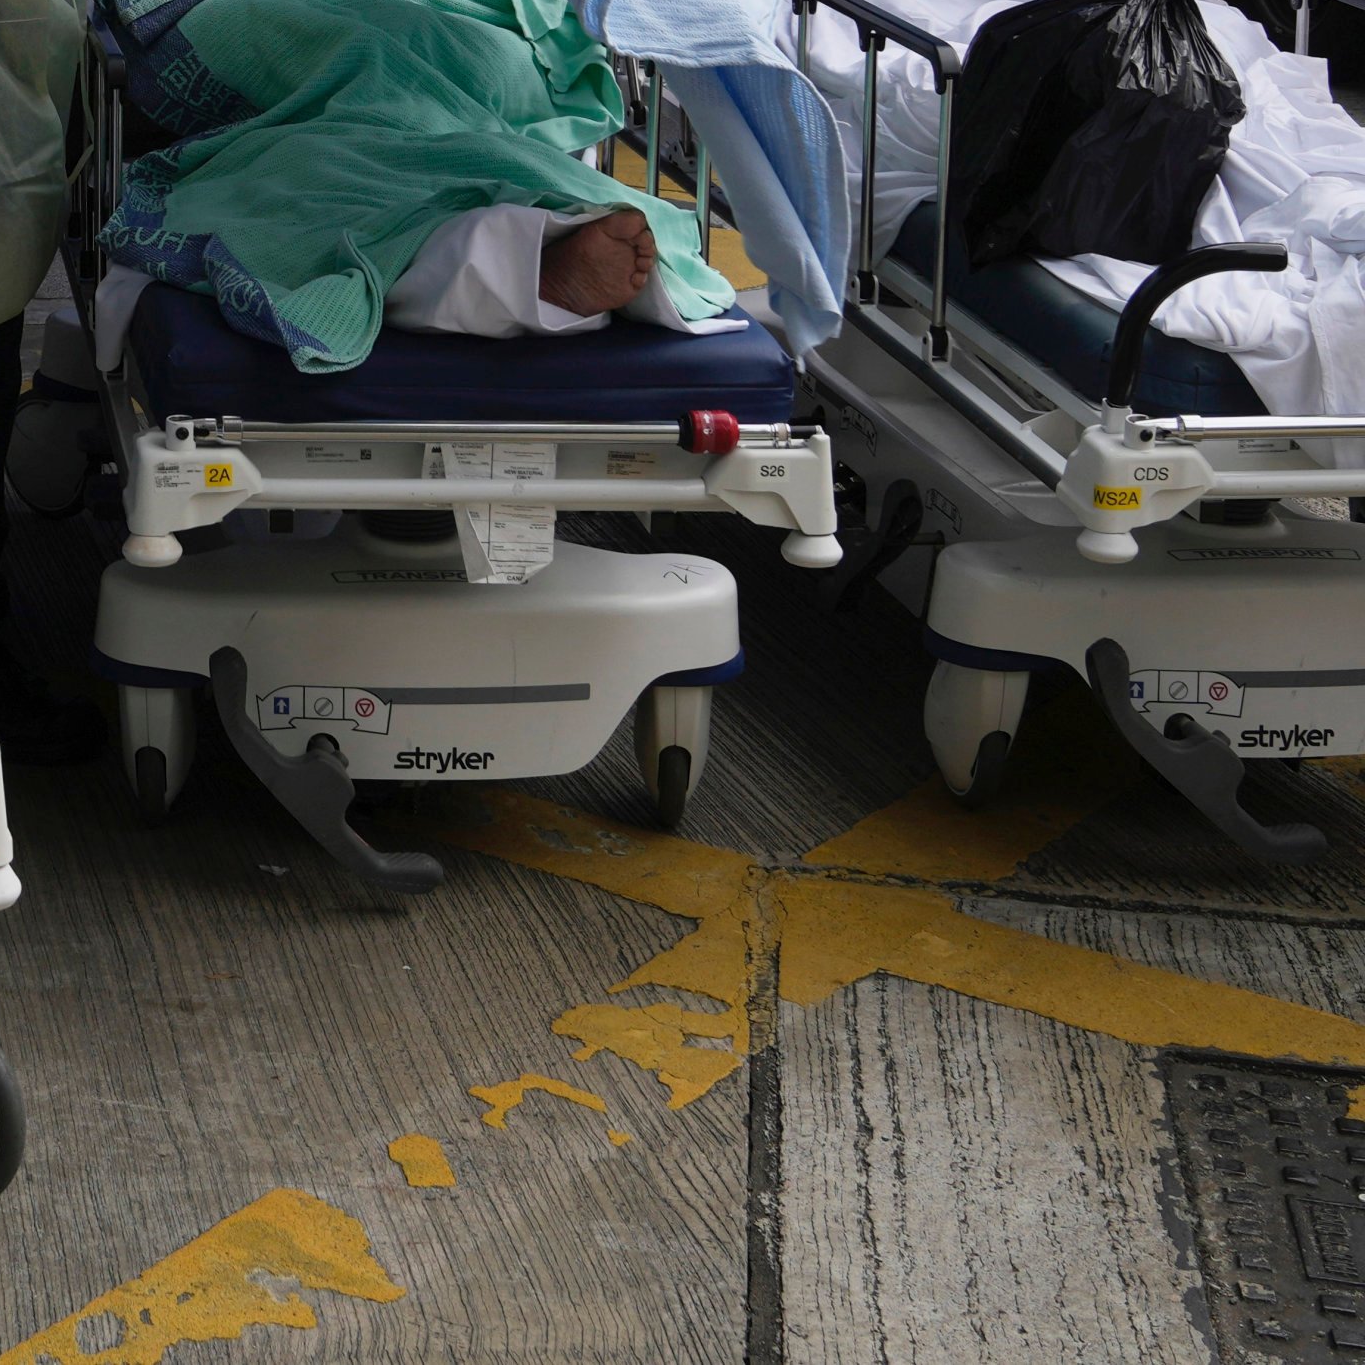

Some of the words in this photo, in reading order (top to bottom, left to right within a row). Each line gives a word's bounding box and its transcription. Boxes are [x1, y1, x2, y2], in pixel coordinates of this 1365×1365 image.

[209, 468, 231, 482] 2A
[760, 465, 785, 477] S26
[1134, 467, 1169, 481] CDS
[1094, 490, 1139, 506] WS2A
[1197, 549, 1334, 559] TRANSPORT
[357, 571, 467, 581] TRANSPO
[1238, 724, 1334, 751] stryker
[394, 747, 494, 773] stryker
